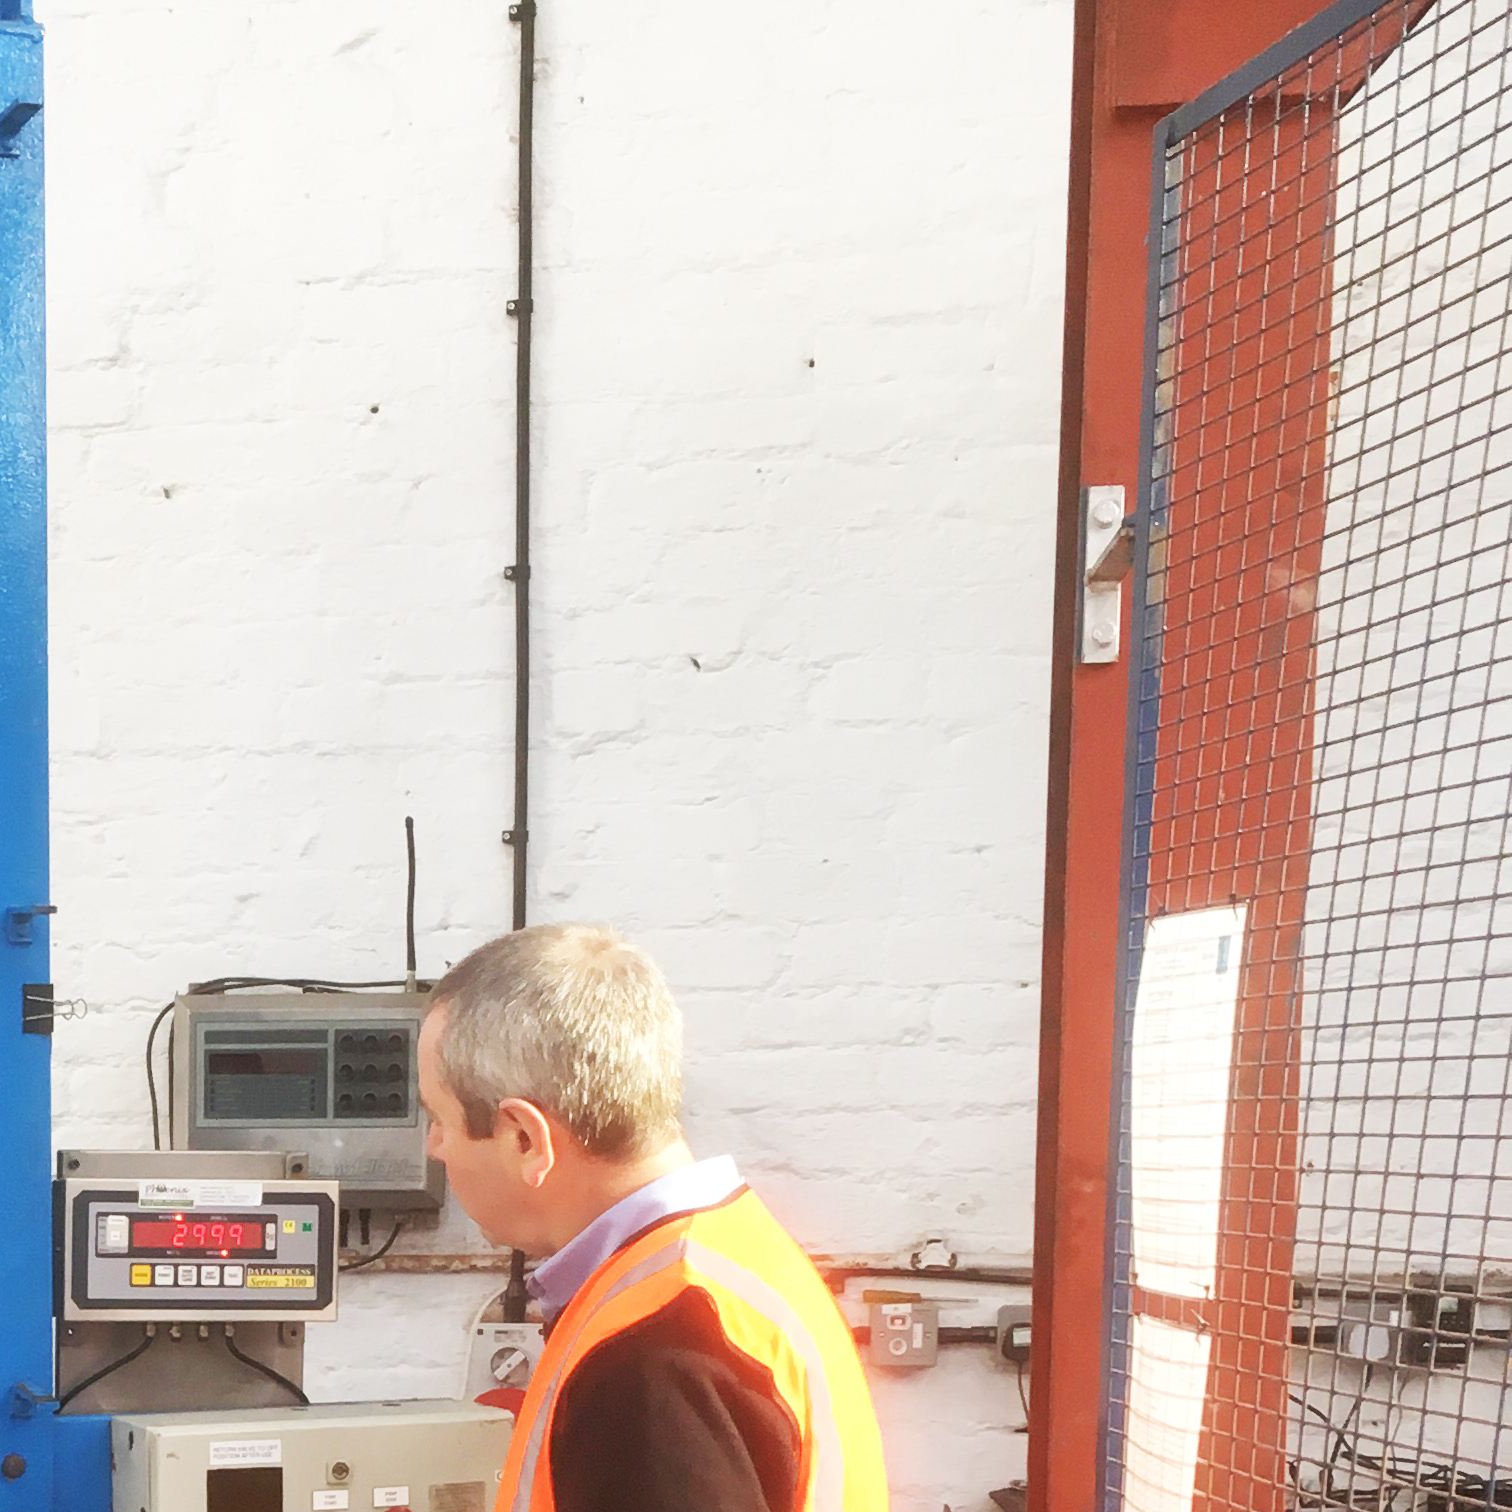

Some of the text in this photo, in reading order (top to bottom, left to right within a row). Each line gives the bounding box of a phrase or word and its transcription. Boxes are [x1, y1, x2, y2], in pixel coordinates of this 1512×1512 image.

[172, 1224, 244, 1248] 2999
[249, 1277, 307, 1287] Series 2100
